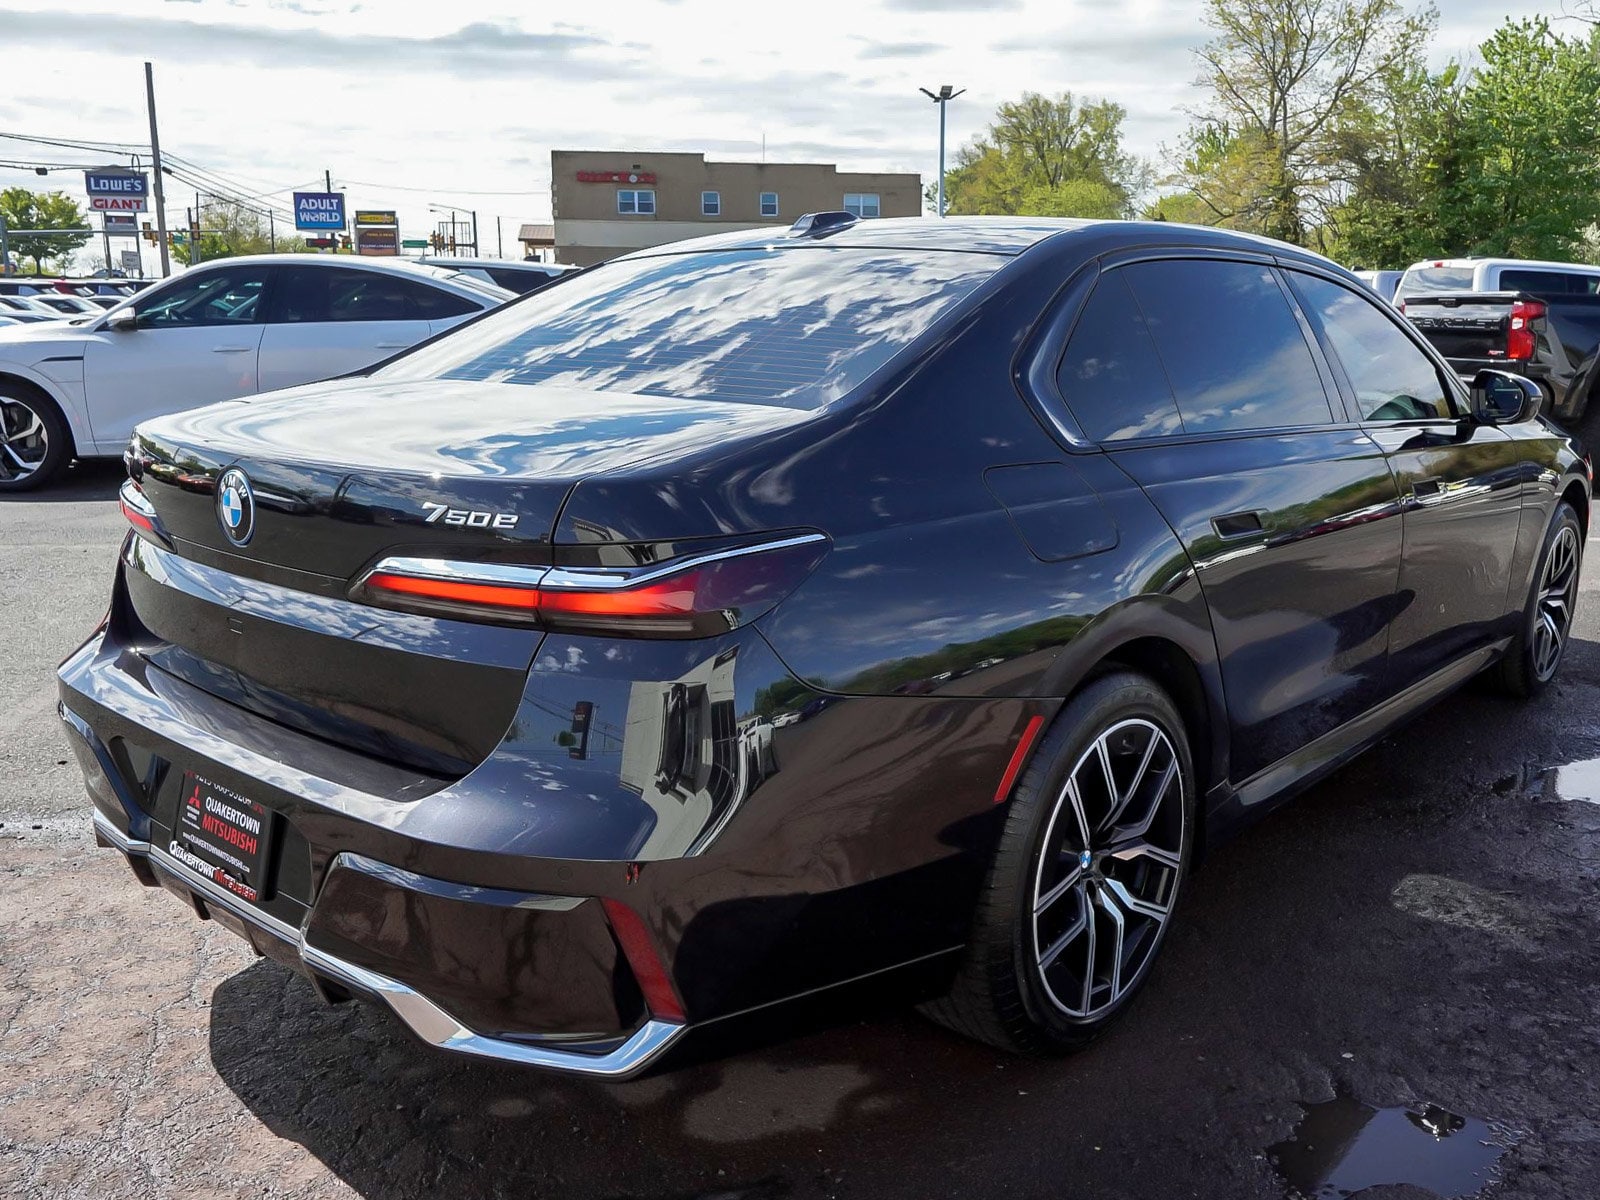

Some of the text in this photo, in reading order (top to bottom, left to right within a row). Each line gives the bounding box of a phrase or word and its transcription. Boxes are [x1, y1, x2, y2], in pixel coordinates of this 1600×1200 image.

[90, 177, 142, 191] LOWE'S
[93, 198, 142, 210] GIANT
[299, 199, 339, 210] ADULT
[299, 211, 341, 223] WORLD
[220, 474, 247, 498] BMW
[421, 501, 519, 529] 750e
[205, 796, 260, 835] QUAKERTOWN
[202, 813, 257, 855] MITSUBISHI
[169, 840, 216, 879] QUAKERTOWN
